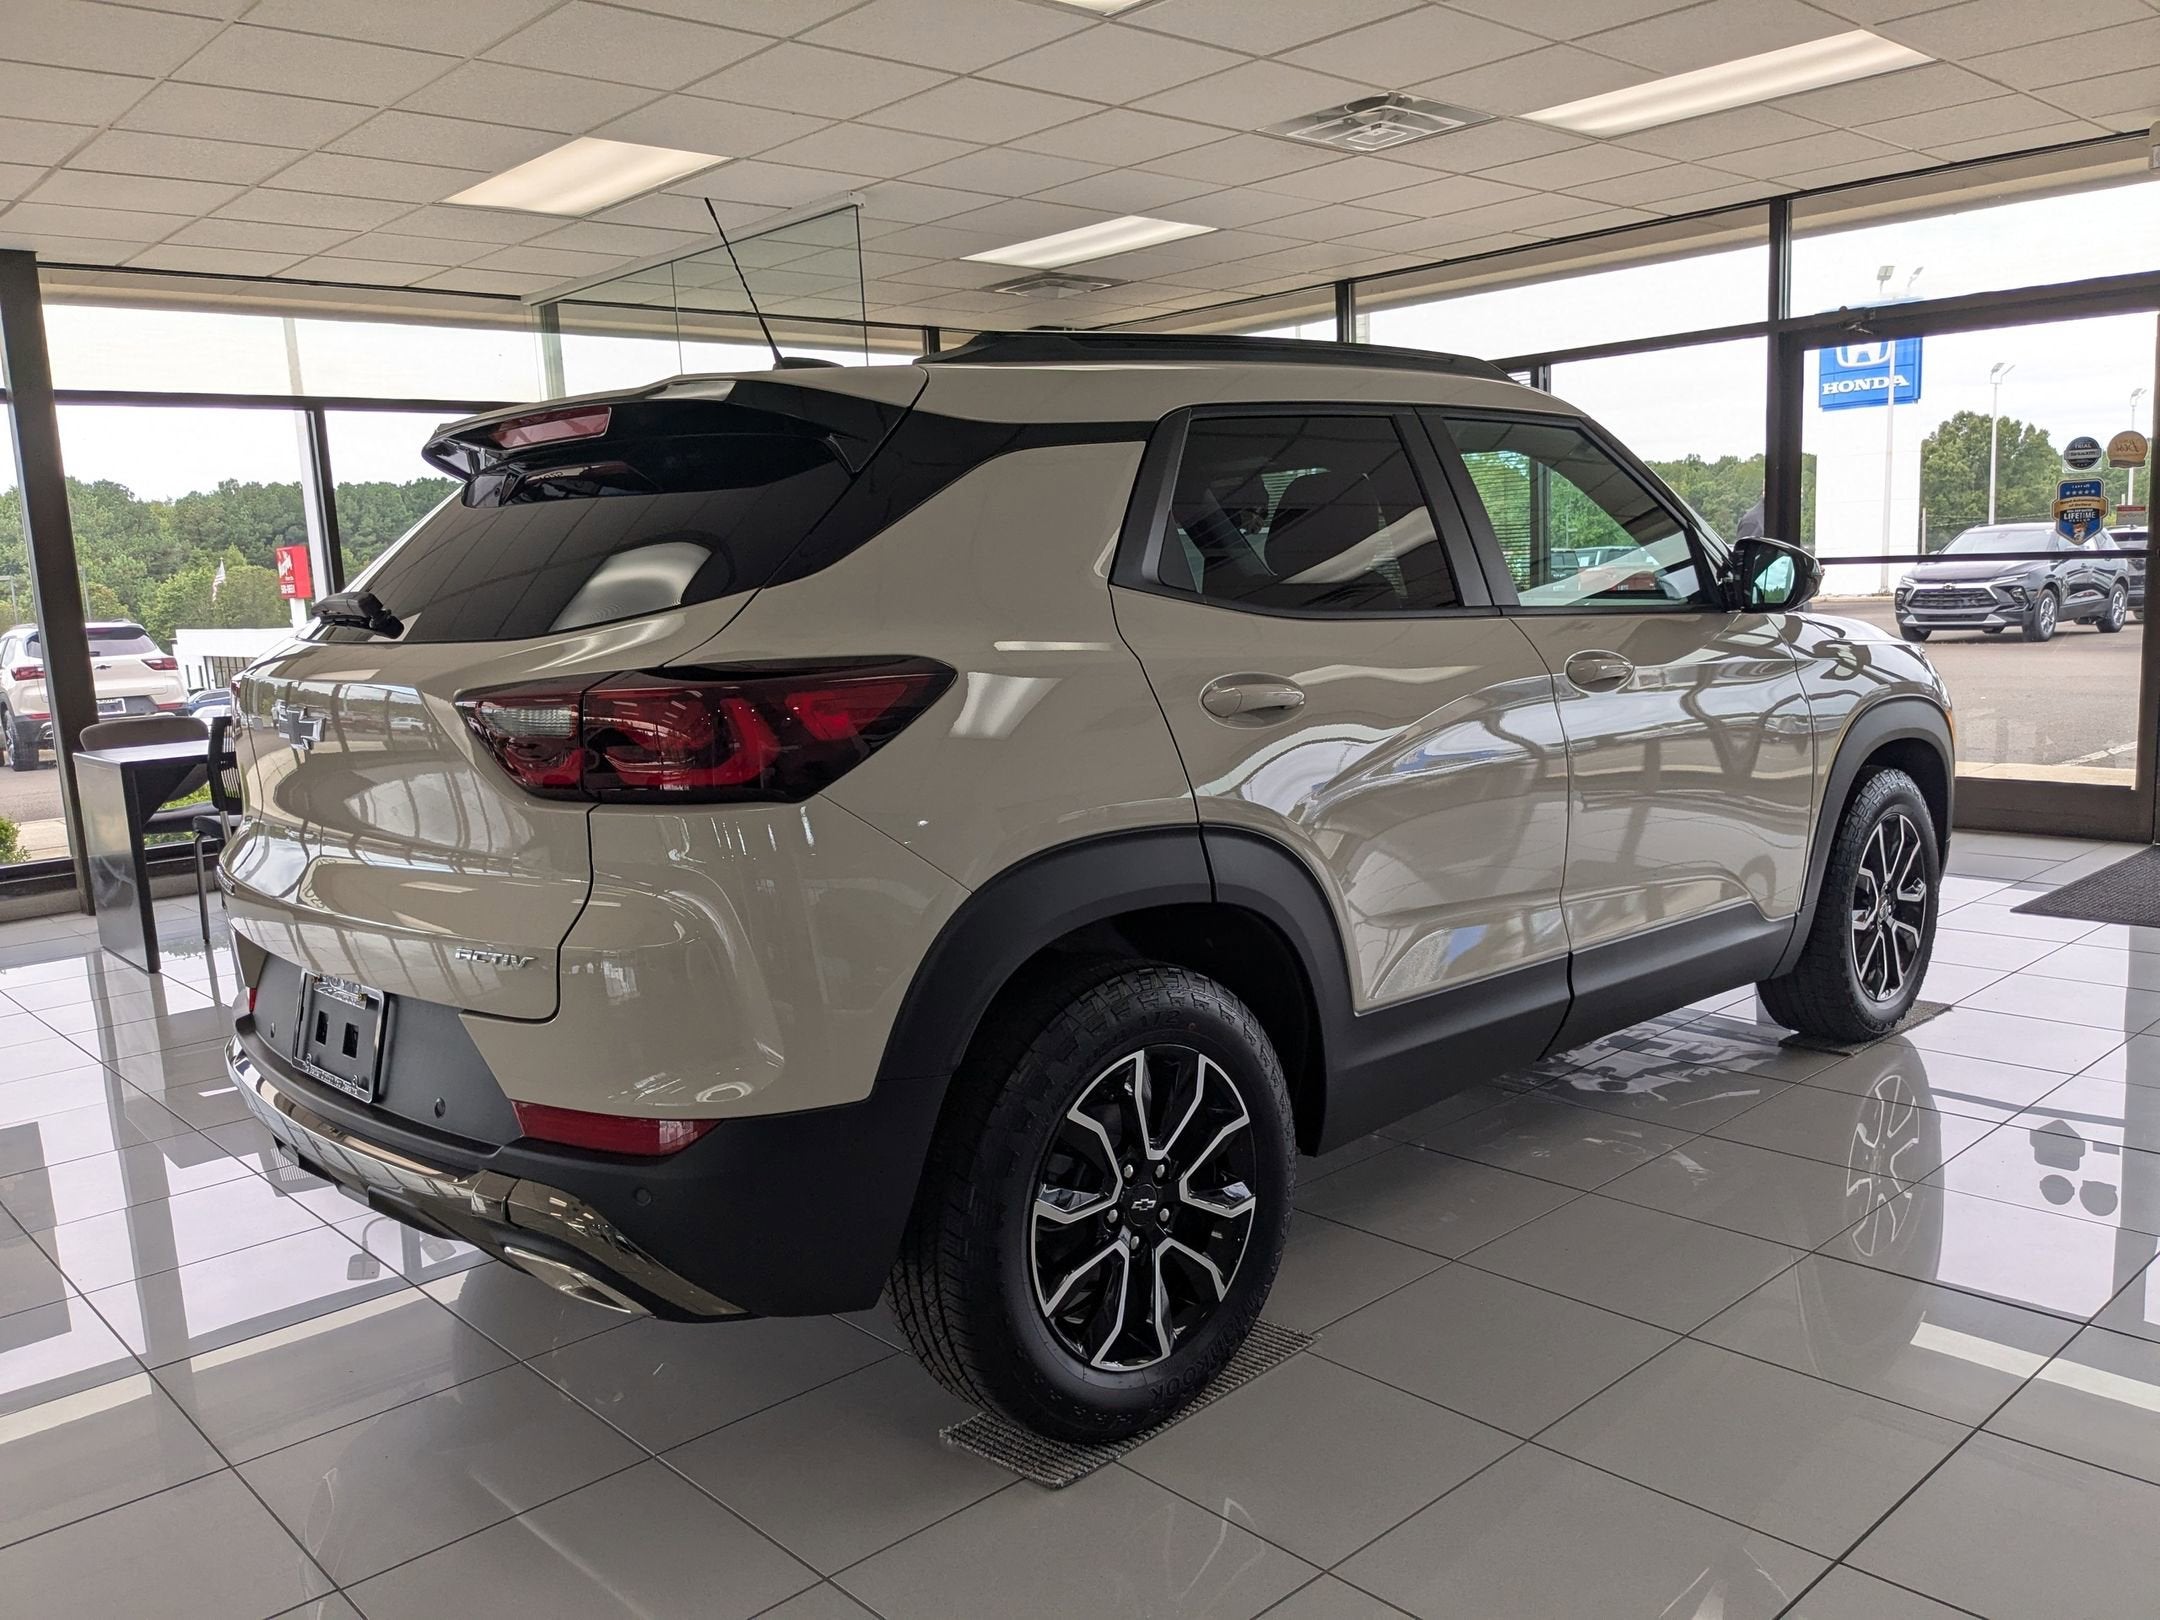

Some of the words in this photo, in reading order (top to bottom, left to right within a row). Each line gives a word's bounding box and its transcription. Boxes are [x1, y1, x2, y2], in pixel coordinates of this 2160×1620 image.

[1822, 374, 1910, 395] HONDA
[2063, 511, 2096, 520] LIFETIME
[455, 947, 538, 969] ACTIV
